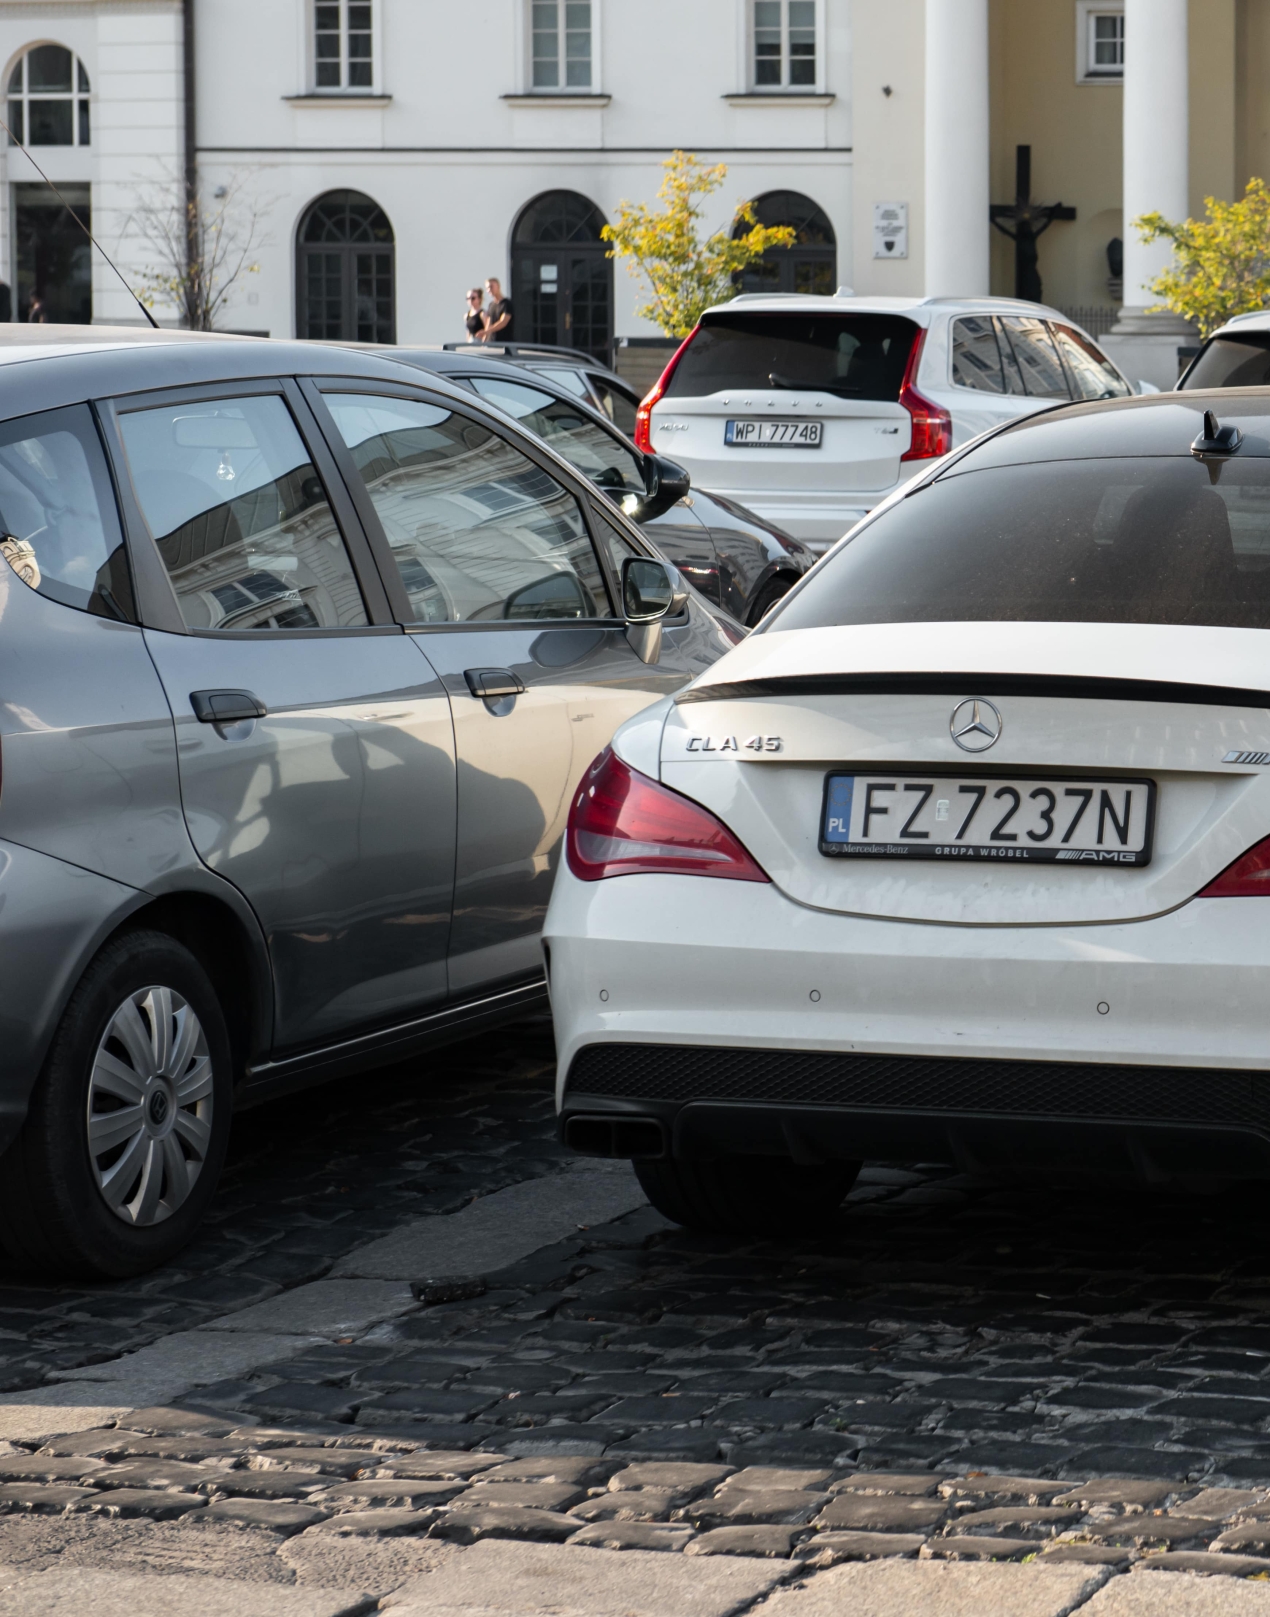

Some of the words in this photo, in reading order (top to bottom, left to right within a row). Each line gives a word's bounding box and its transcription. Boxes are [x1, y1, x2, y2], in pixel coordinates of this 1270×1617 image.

[735, 423, 762, 440] WPI
[770, 424, 819, 442] 77748
[685, 735, 738, 752] CLA
[743, 735, 784, 752] 45
[862, 782, 934, 839] FZ
[954, 784, 1133, 846] 7237N
[828, 817, 847, 834] PL
[842, 843, 909, 856] Mercedes-Benz
[935, 847, 975, 857] GRUPA
[980, 846, 1030, 859] WRÓBEL
[1079, 850, 1137, 863] AMG
